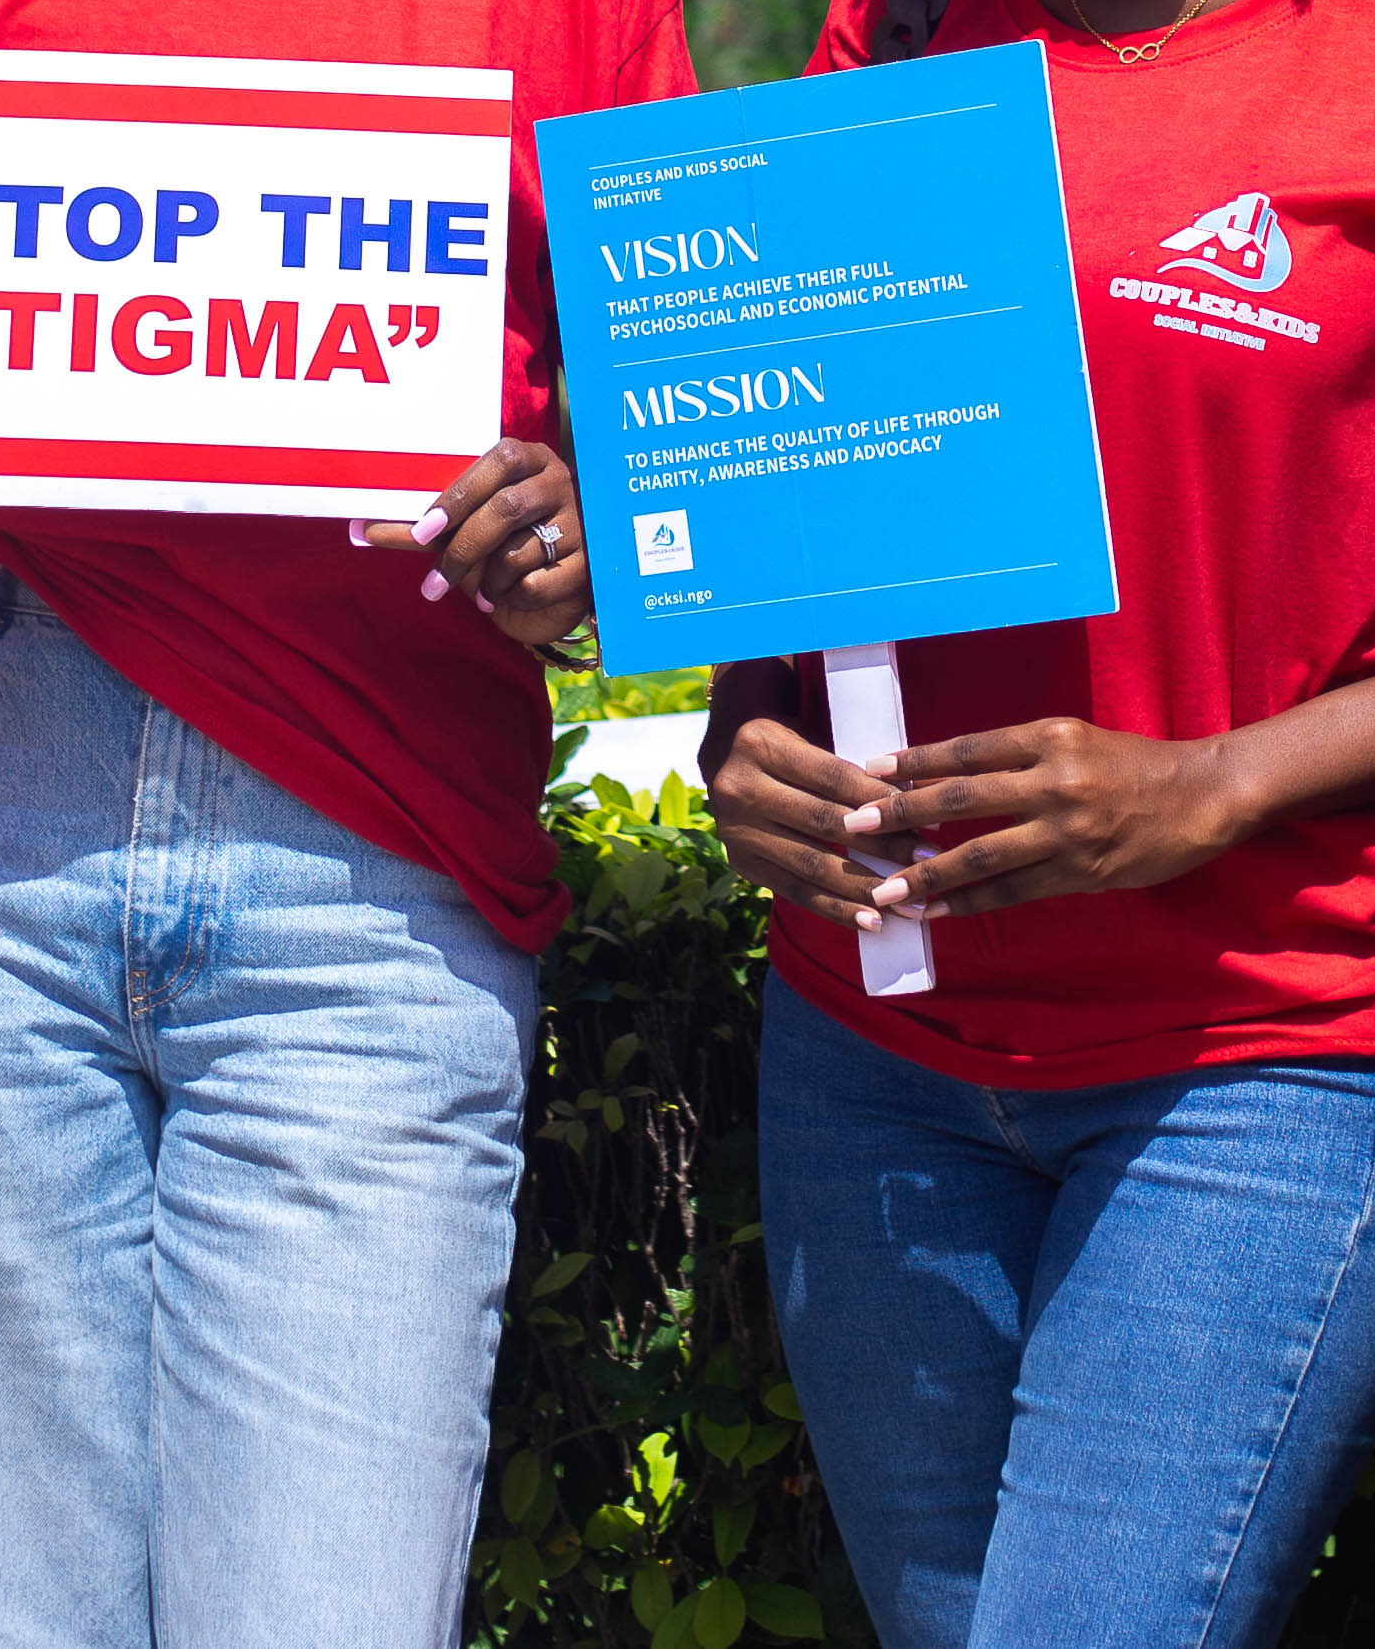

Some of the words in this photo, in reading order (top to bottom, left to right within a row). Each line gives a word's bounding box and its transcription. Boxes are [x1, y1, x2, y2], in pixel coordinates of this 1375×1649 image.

[591, 170, 652, 192] COUPLES
[655, 165, 683, 182] AND
[685, 160, 717, 177] KIDS
[720, 153, 768, 172] SOCIAL
[593, 188, 662, 210] INITIATIVE
[260, 193, 489, 276] THE
[600, 222, 759, 283] VISION
[606, 296, 650, 318] THAT
[654, 287, 719, 311] PEOPLE
[722, 275, 793, 302] ACHIEVE
[795, 267, 848, 290] THEIR
[850, 261, 894, 282] FULL
[610, 308, 736, 341] PSYCHOSOCIAL
[739, 301, 775, 322] AND
[778, 287, 870, 317] ECONOMIC
[872, 273, 968, 303] POTENTIAL
[1109, 277, 1321, 344] COUPLES&KIDS
[1153, 313, 1199, 334] SOCIAL
[1200, 323, 1266, 351] INITIATIVE
[622, 363, 825, 430] MISSION
[625, 453, 648, 471] TO
[652, 440, 732, 467] ENHANCE
[734, 435, 768, 456] THE
[771, 424, 843, 453] QUALITY
[847, 421, 870, 439] OF
[874, 415, 910, 435] LIFE
[912, 402, 1000, 430] THROUGH
[628, 468, 705, 493] CHARITY,
[708, 455, 810, 483] AWARENESS
[813, 449, 850, 468] AND
[852, 434, 943, 463] ADVOCACY
[644, 589, 713, 610] @cksi.ngo
